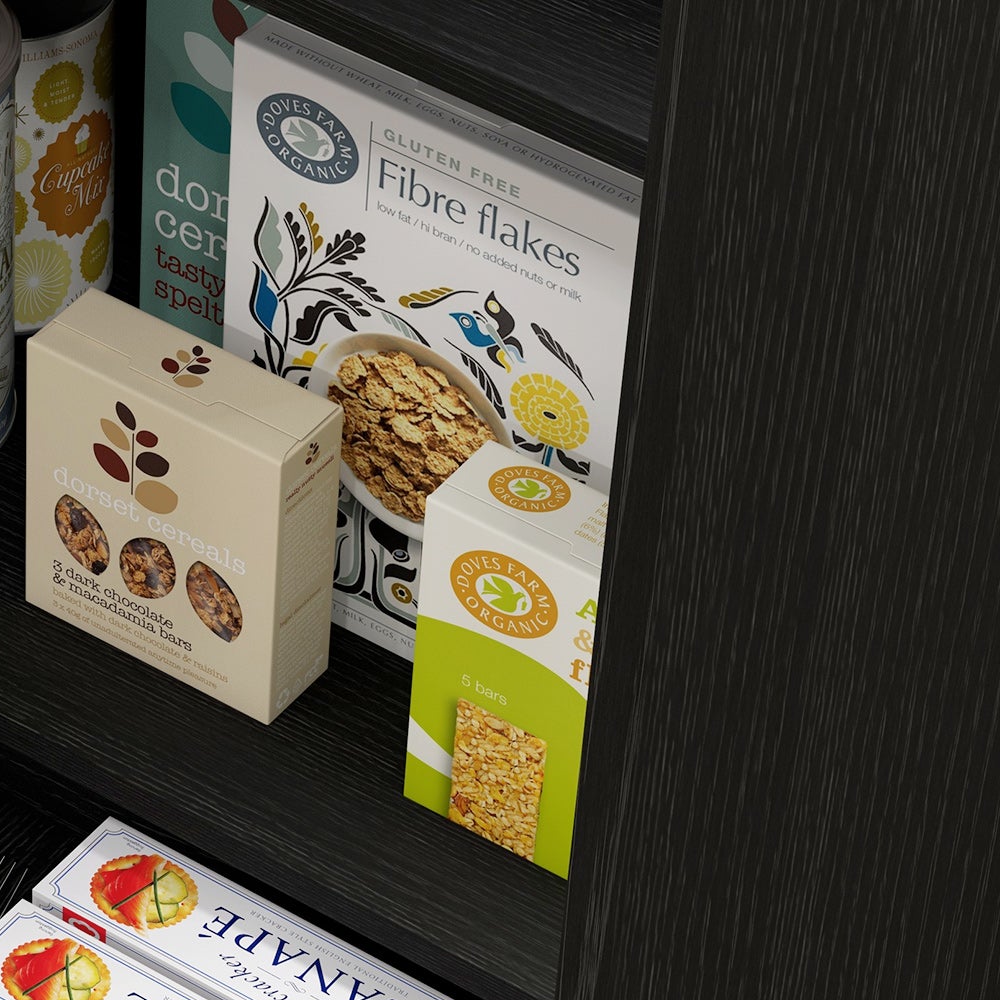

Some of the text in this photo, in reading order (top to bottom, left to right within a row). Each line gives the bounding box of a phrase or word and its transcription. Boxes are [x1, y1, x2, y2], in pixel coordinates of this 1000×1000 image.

[21, 30, 98, 63] ILLIAMS-SONOMA
[262, 98, 353, 161] DOVES FARM
[264, 34, 638, 204] MADE WITHOUT WHEAT, MILK, EGGS, NUTS, SOYA OR HYDROGENATED FAT
[39, 140, 111, 195] Cupcake
[267, 133, 348, 180] ORGANIC
[383, 128, 521, 199] GLUTEN FREE
[64, 175, 106, 216] Mix
[378, 157, 580, 277] Fibre flakes
[154, 244, 226, 299] tasty
[377, 200, 396, 217] low
[398, 210, 412, 225] fat
[420, 220, 430, 233] hi
[432, 225, 458, 246] bran
[466, 242, 481, 256] no
[482, 248, 518, 273] added
[520, 267, 544, 285] nuts
[545, 280, 558, 291] or
[559, 284, 582, 303] milk
[154, 279, 225, 328] spelt
[494, 467, 566, 500] DOVES FARM
[494, 486, 557, 511] ORGANIC
[53, 466, 140, 523] dorset
[147, 514, 247, 577] cereals
[52, 559, 174, 630] 3 dark chocolate
[456, 556, 550, 608] DOVES FARM
[52, 572, 193, 652] & macadamia bars
[52, 586, 83, 608] baked
[84, 600, 107, 622] with
[108, 614, 134, 636] dark
[134, 628, 181, 660] chocolate
[192, 659, 229, 684] raisins
[342, 608, 367, 626] MILK,
[370, 622, 397, 641] EGGS,
[466, 595, 549, 635] ORGANIC
[461, 673, 507, 706] 5 bars
[249, 909, 410, 999] TRADITIONAL ENGLISH STYLE CRACKER
